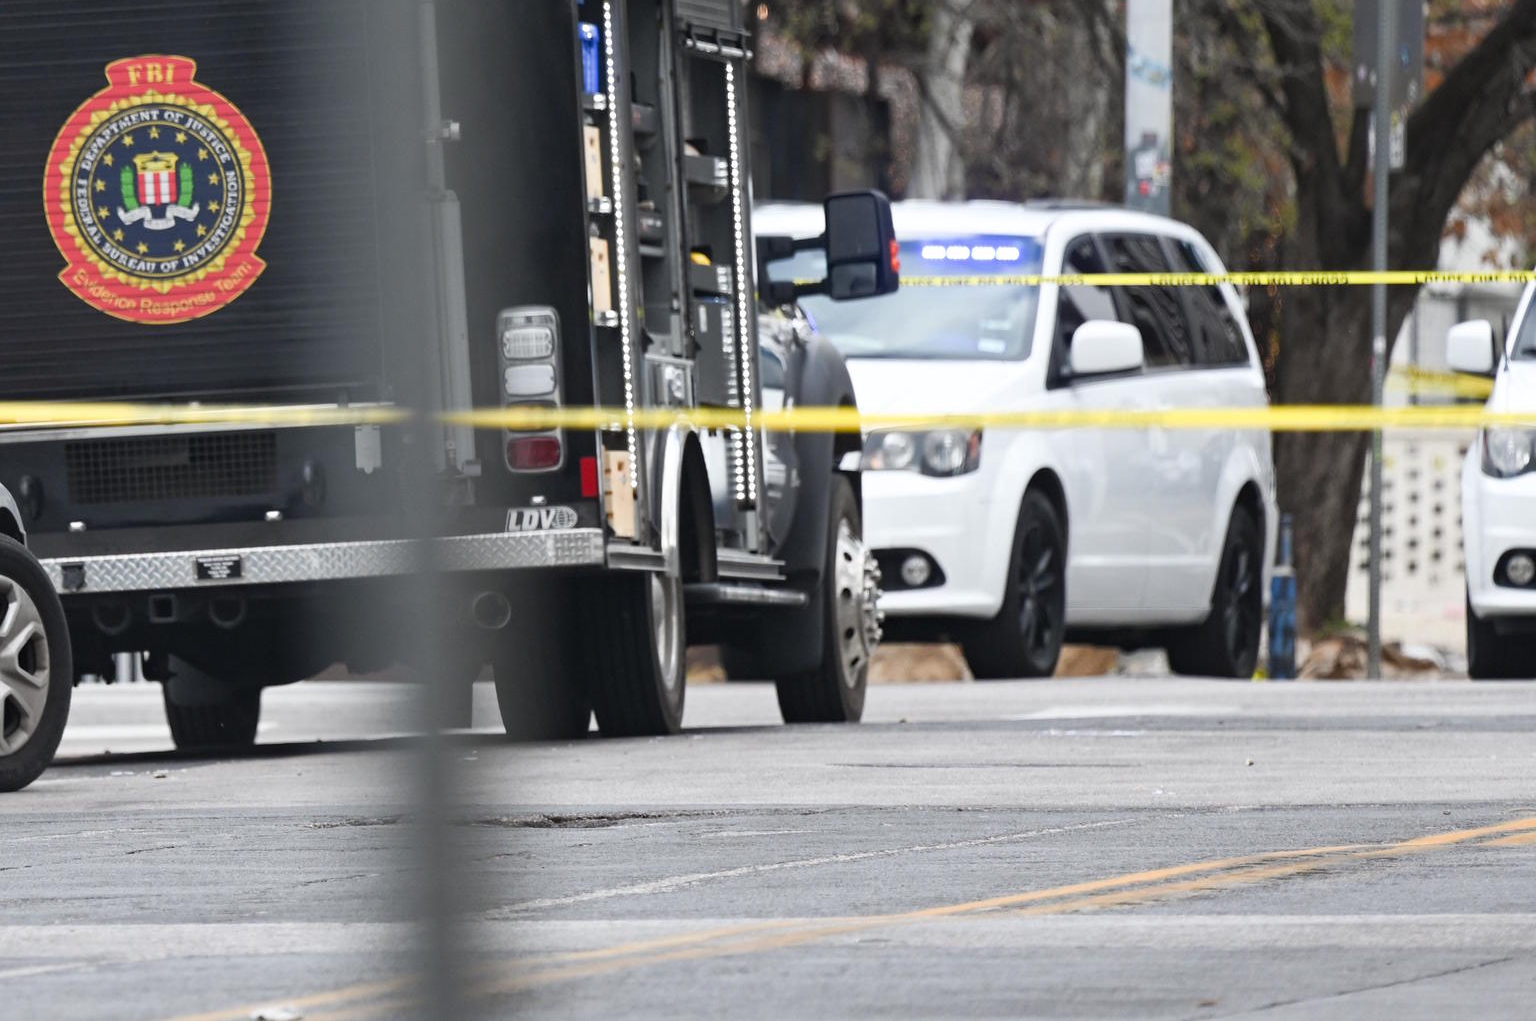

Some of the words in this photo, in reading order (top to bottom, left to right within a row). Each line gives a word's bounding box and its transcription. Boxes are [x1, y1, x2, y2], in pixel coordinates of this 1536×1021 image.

[126, 63, 175, 86] FBI
[81, 109, 159, 172] DEPARTMENT
[164, 109, 185, 123] OF
[185, 116, 232, 165] JUSTICE
[76, 178, 103, 244] FEDERAL
[101, 240, 157, 273] BUREAU
[160, 259, 180, 273] OF
[183, 170, 240, 268] INVESTIGATION
[72, 267, 137, 310] Evidence
[139, 293, 216, 316] Response
[214, 261, 253, 295] Team
[508, 509, 556, 531] LDV
